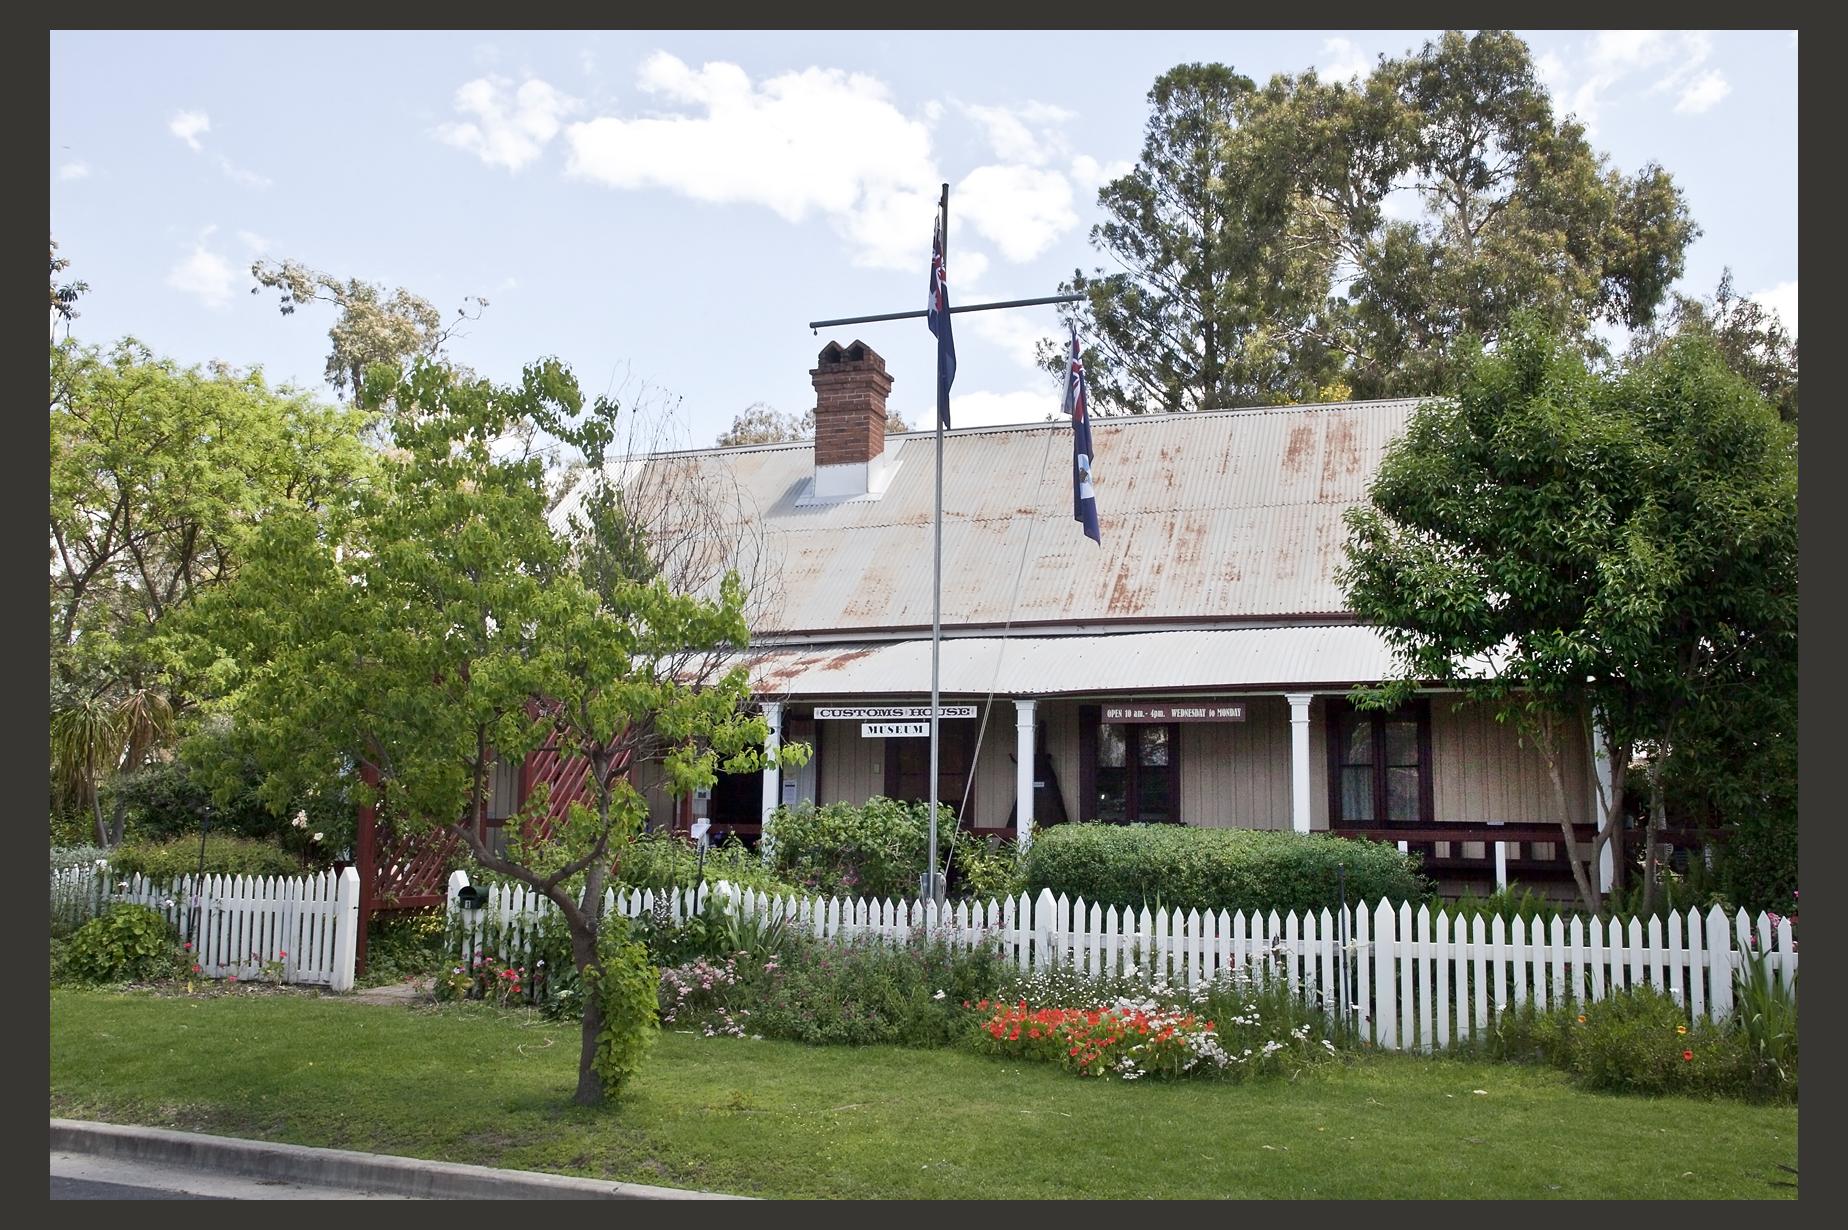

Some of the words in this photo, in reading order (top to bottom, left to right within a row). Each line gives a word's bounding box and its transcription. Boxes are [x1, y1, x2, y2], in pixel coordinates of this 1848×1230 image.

[820, 709, 904, 718] CUSTOMS
[910, 708, 970, 717] HOUSE
[1107, 709, 1122, 718] OPEN
[1125, 709, 1131, 718] 10
[1171, 708, 1206, 718] WEDNESDAY
[1208, 709, 1215, 717] to
[1217, 708, 1241, 717] MONDAY
[867, 725, 923, 734] MUSEUM
